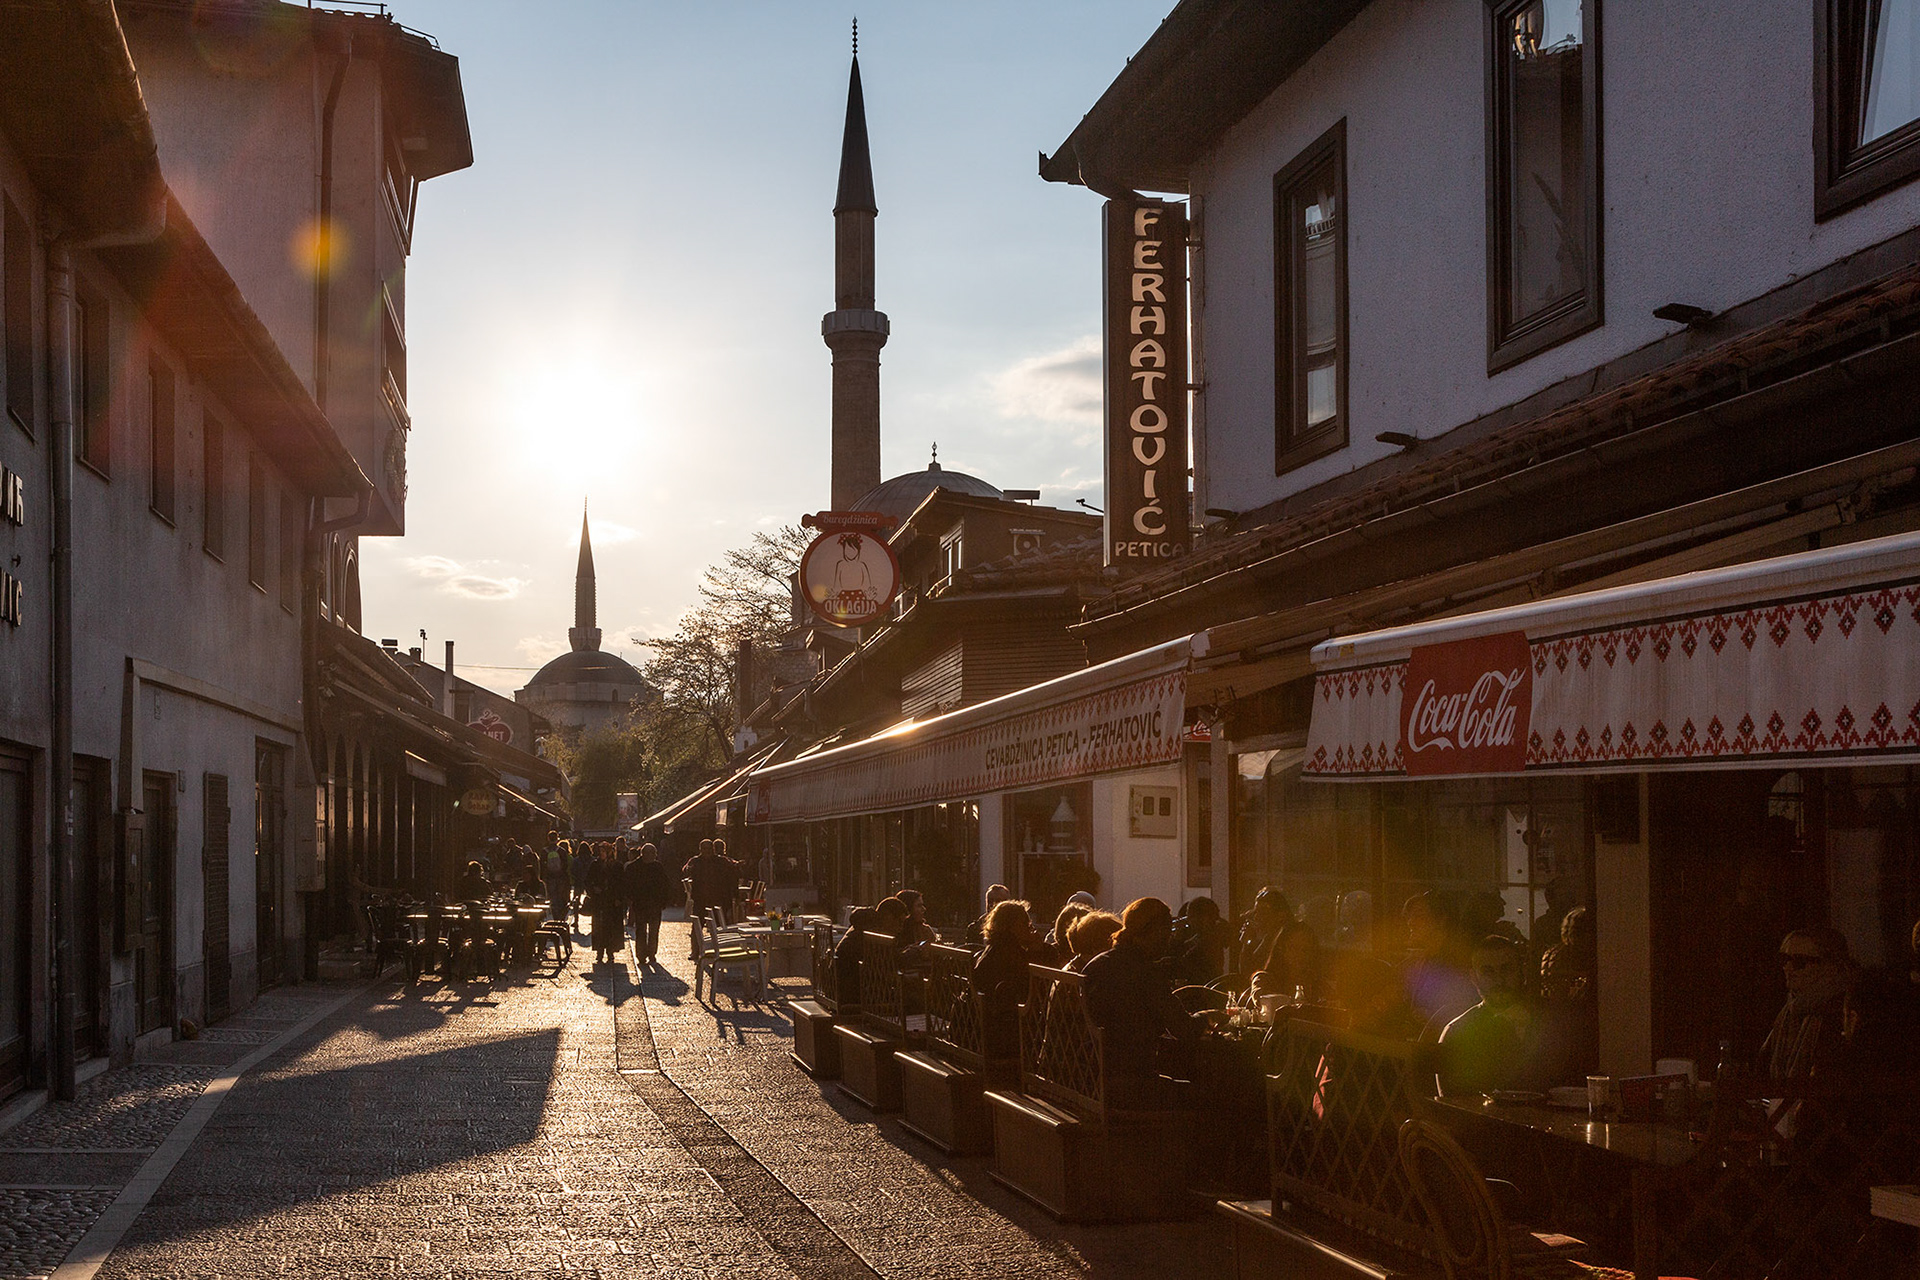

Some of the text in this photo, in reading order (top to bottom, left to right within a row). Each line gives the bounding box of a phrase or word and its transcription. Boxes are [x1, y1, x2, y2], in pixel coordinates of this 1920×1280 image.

[1129, 207, 1169, 536] FERHATOVIĆ
[822, 515, 878, 527] Buregdžinica
[1114, 541, 1185, 557] PETICA
[825, 599, 877, 614] OKLAGIJA
[1408, 667, 1527, 753] Coca-Cola
[483, 730, 505, 741] NET
[1045, 729, 1079, 758] PETICA
[1088, 703, 1162, 750] FERHATOVIĆ
